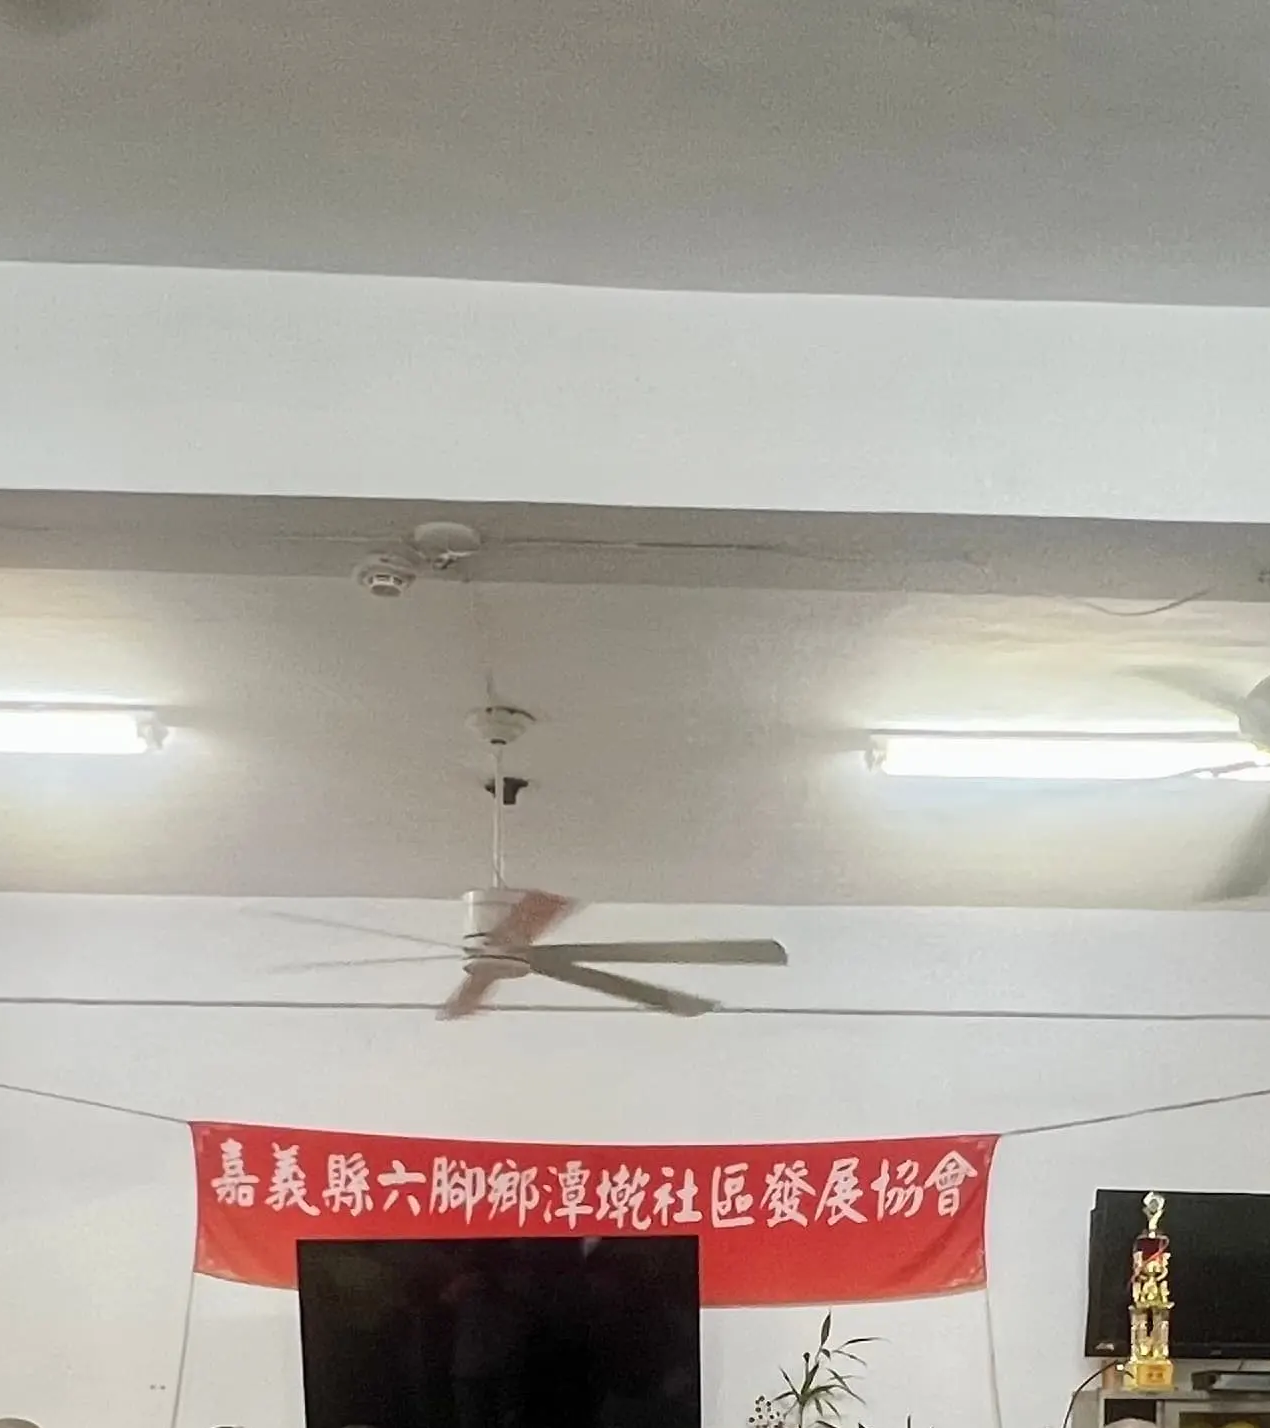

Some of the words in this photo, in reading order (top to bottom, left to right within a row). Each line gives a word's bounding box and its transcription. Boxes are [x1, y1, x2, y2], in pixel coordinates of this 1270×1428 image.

[210, 1138, 978, 1231] 嘉義縣六腳鄉潭墘社區發展協會
